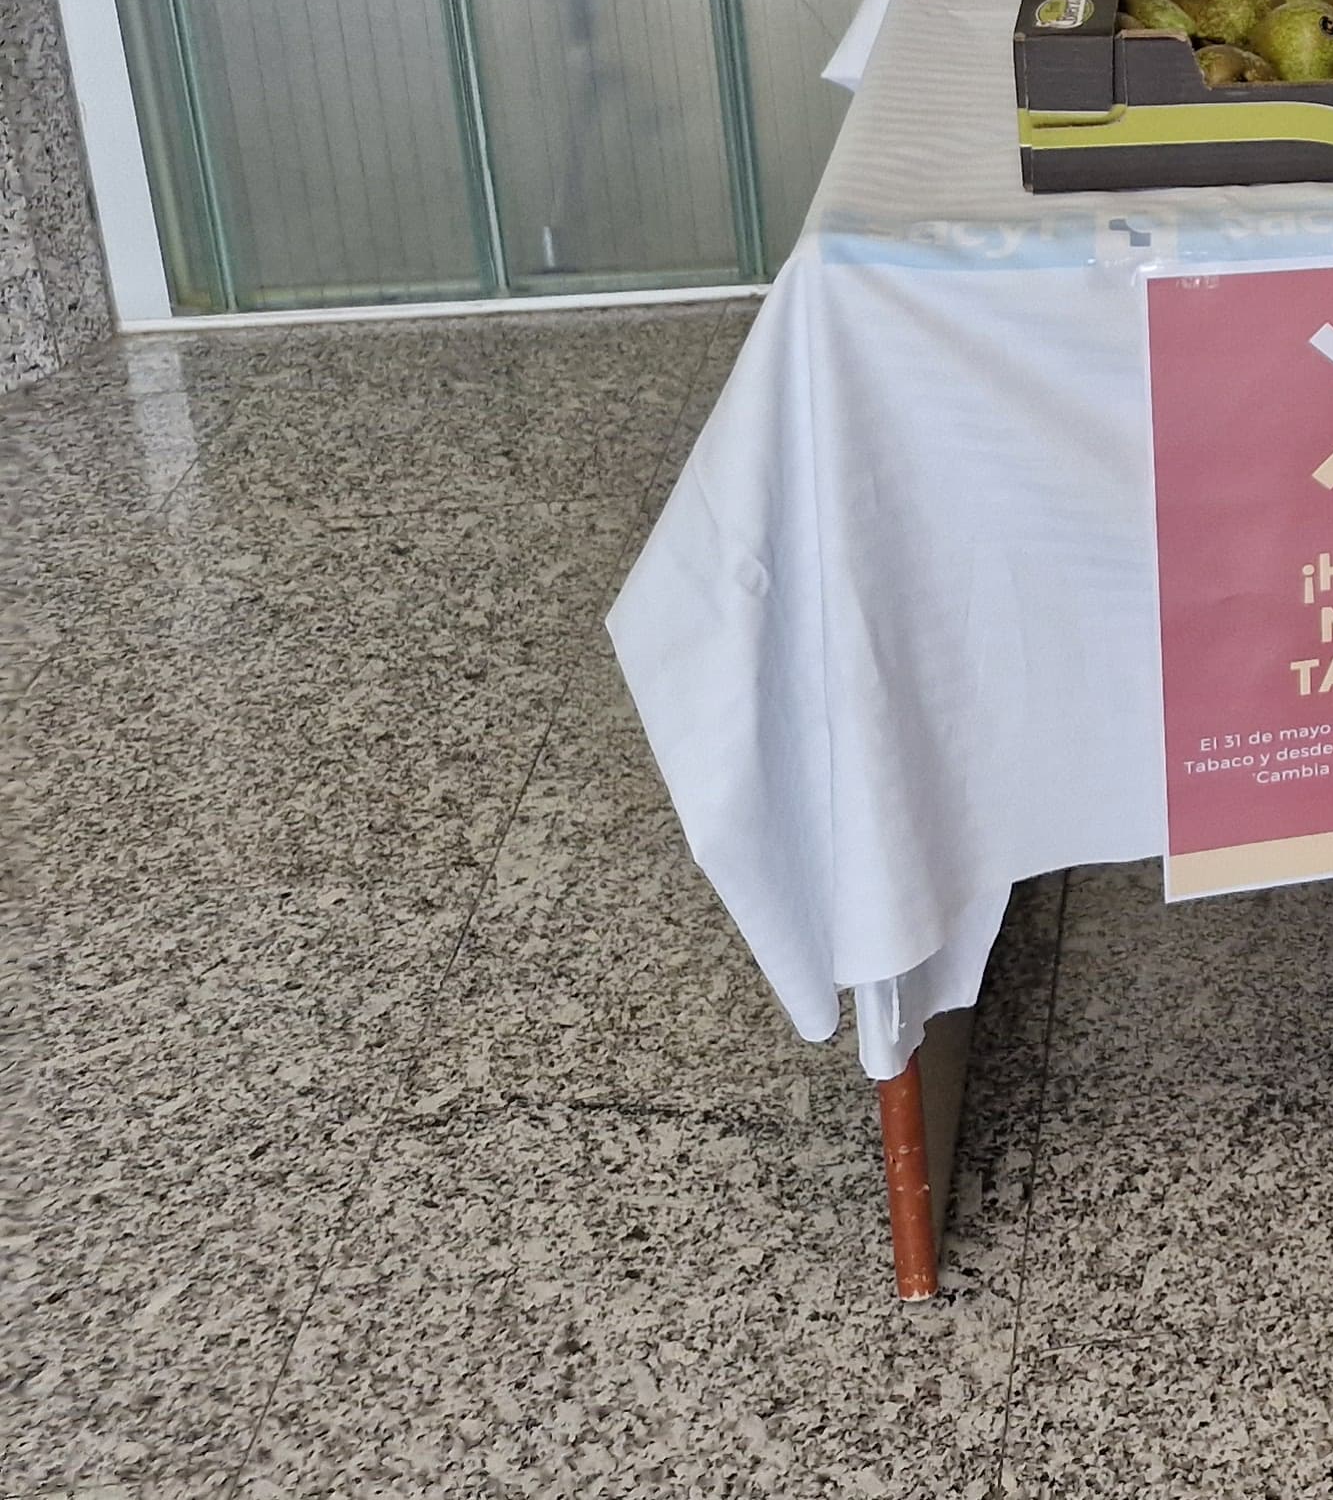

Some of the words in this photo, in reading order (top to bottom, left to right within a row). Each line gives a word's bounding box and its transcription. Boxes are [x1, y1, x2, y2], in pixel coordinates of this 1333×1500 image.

[1200, 737, 1217, 751] El
[1224, 734, 1241, 748] 31
[1249, 731, 1273, 745] de
[1280, 724, 1331, 740] mayo
[1184, 755, 1254, 774] Tabaco
[1260, 752, 1270, 767] y
[1276, 743, 1333, 762] desde
